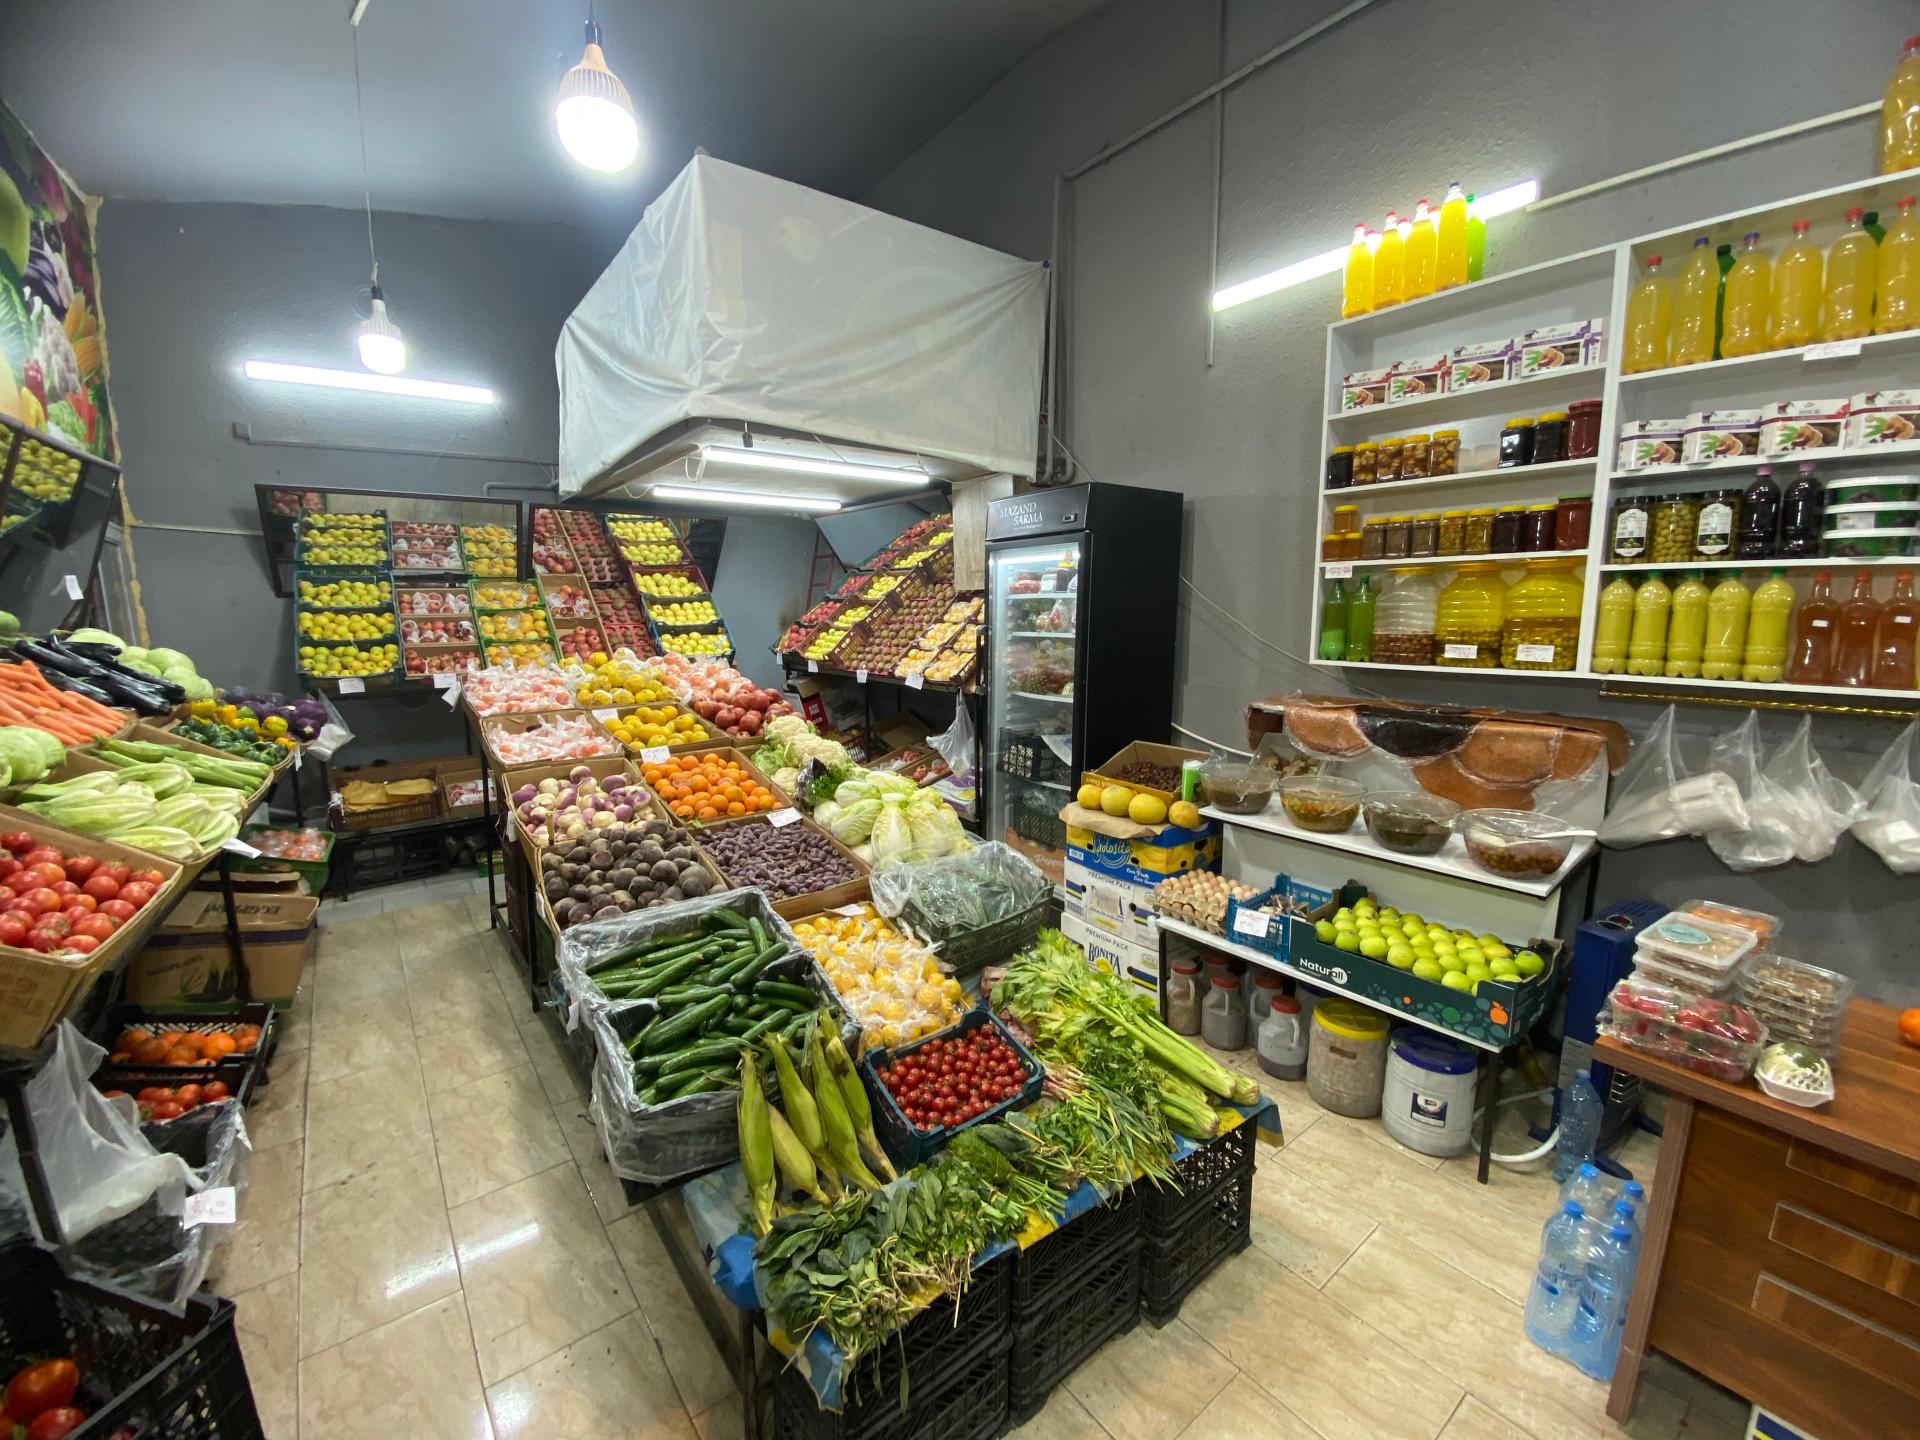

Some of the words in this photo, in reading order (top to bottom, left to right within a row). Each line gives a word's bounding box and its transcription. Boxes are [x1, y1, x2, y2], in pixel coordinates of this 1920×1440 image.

[1013, 512, 1043, 526] SARMA
[1087, 871, 1114, 887] PREMIUM
[1116, 881, 1131, 891] PACK
[1086, 928, 1112, 943] PREMIUM
[1113, 940, 1129, 952] PACK
[1088, 943, 1121, 976] BONITA
[1300, 958, 1345, 981] Naturall
